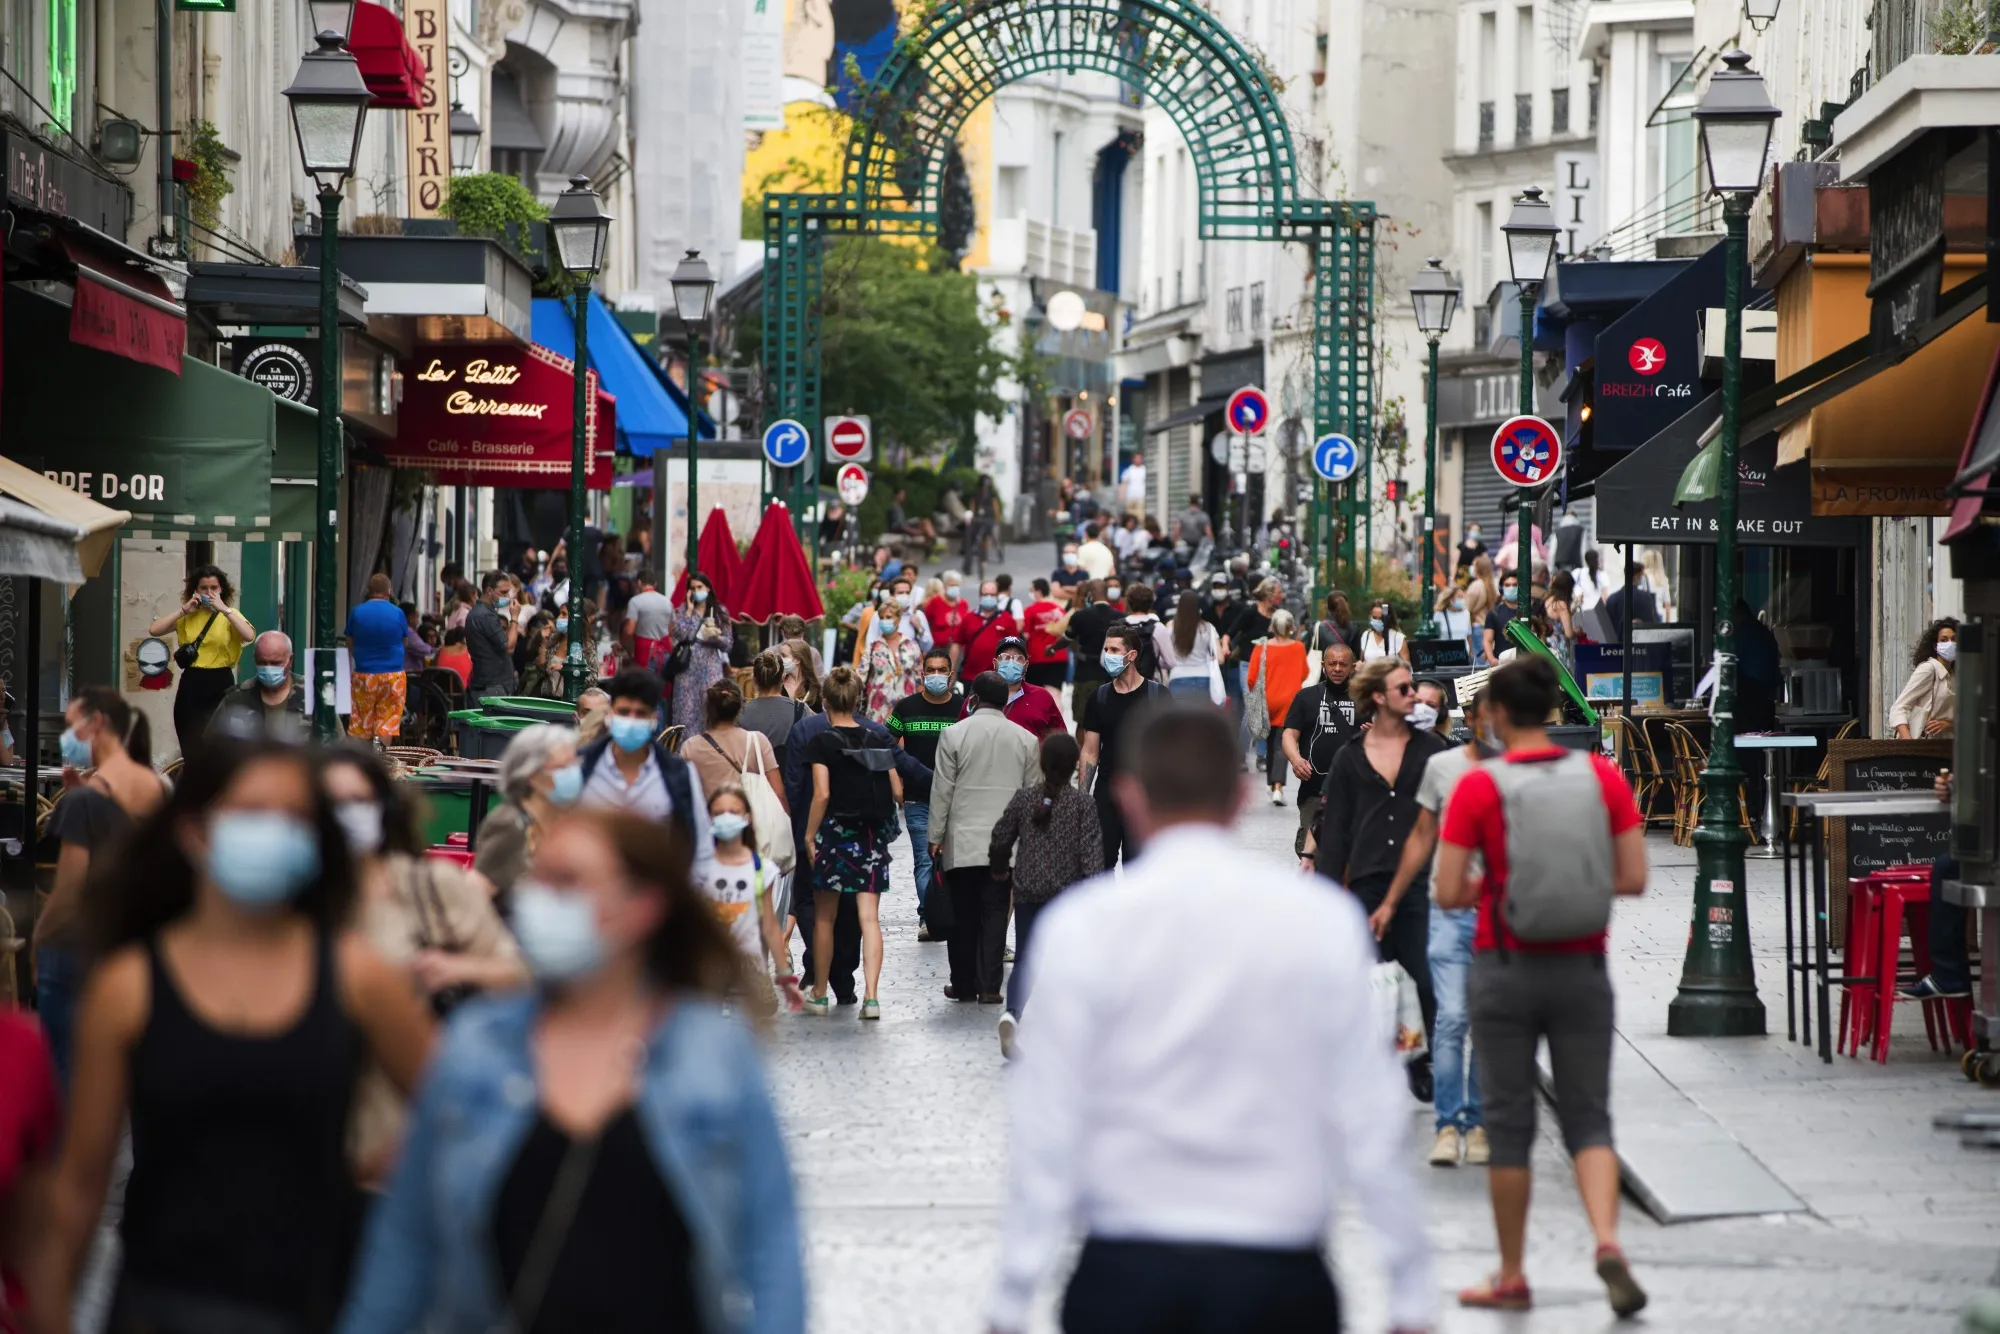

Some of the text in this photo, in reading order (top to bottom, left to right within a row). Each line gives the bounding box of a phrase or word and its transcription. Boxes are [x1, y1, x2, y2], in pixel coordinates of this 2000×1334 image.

[414, 9, 441, 211] BISTRO
[256, 374, 296, 382] CHAMBRE
[417, 359, 521, 385] Les Petits
[1602, 382, 1691, 397] BREIZH Café
[446, 391, 548, 420] Carreaux
[427, 439, 459, 452] Café
[472, 441, 535, 455] Brasserie
[1822, 488, 1849, 502] LA
[1651, 516, 1804, 534] EAT IN & AKE OUT
[1856, 768, 1868, 778] La
[1851, 823, 1866, 832] des
